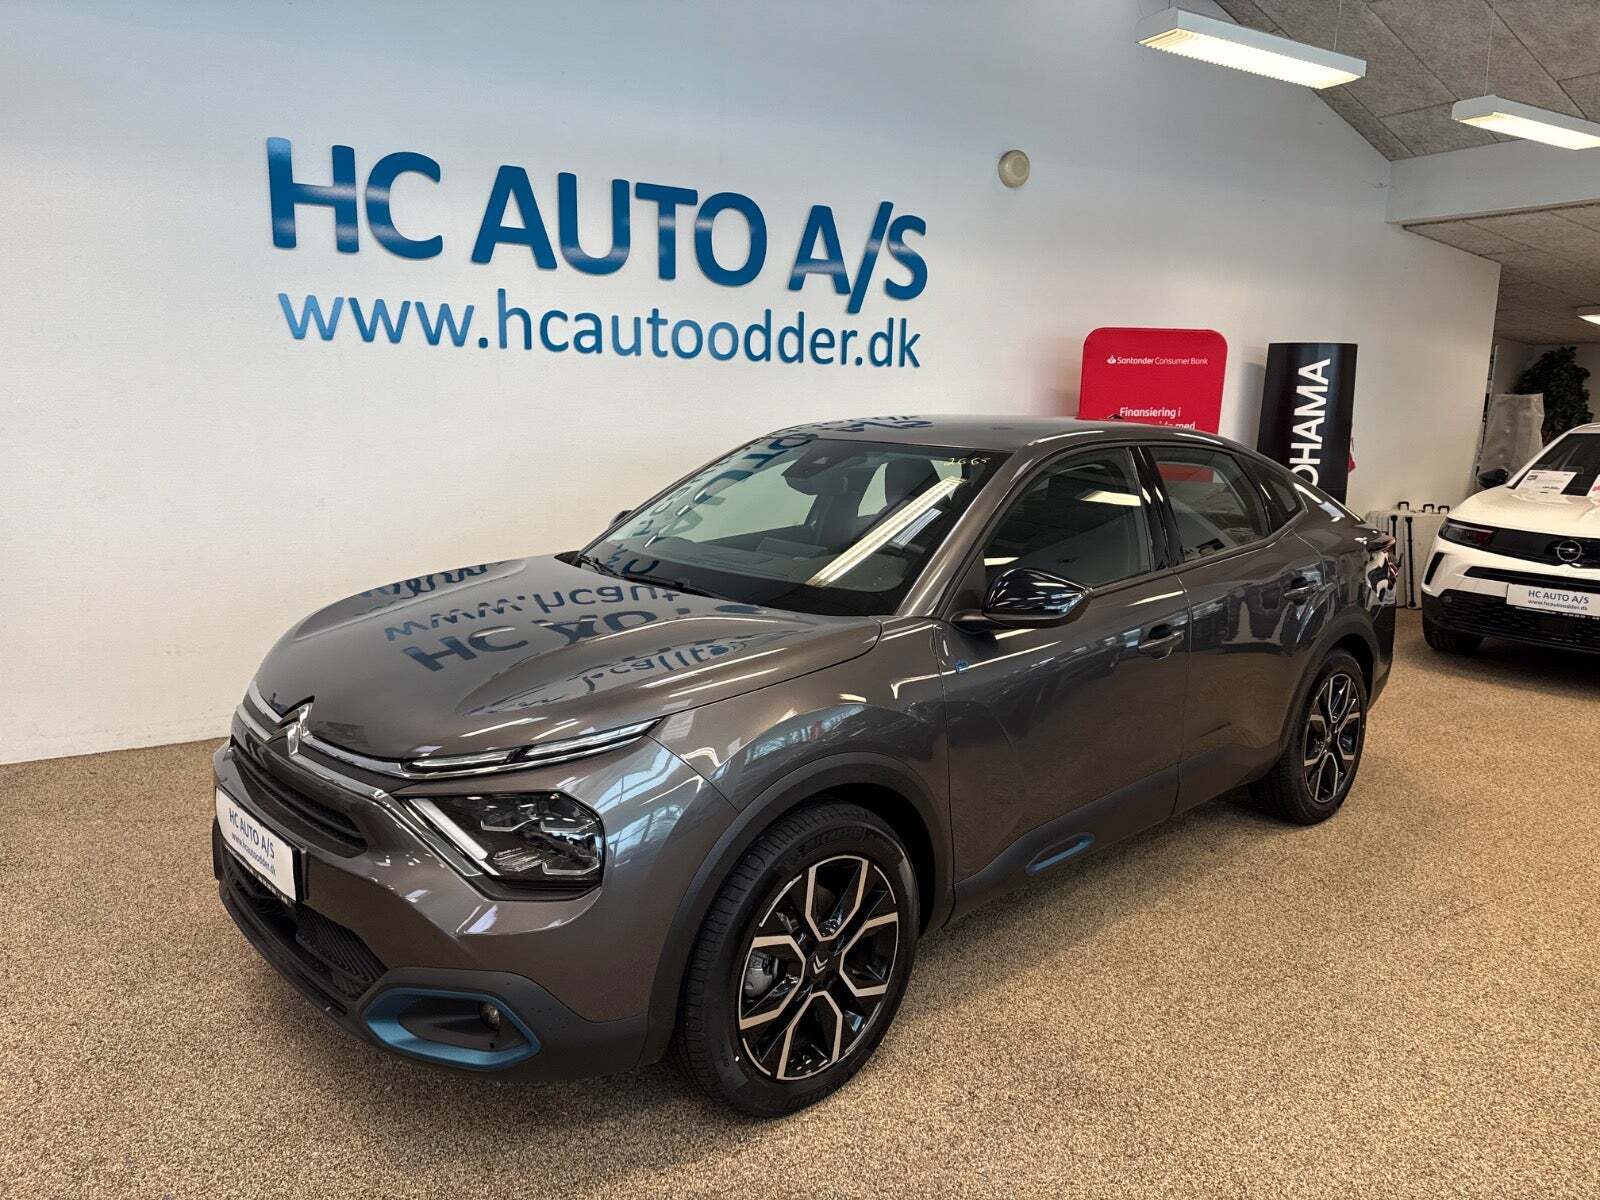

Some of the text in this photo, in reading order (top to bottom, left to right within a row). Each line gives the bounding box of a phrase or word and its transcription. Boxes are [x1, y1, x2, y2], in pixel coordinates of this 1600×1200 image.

[267, 137, 928, 315] HC AUTO A/S
[278, 287, 922, 369] www.hcautoodder.dk
[1117, 356, 1154, 365] Santander
[1155, 357, 1189, 365] Consumer
[1119, 406, 1182, 419] Finansiering i
[1543, 592, 1570, 601] AUTO
[1571, 595, 1590, 604] A/S
[229, 807, 275, 859] HC AUTO A/S
